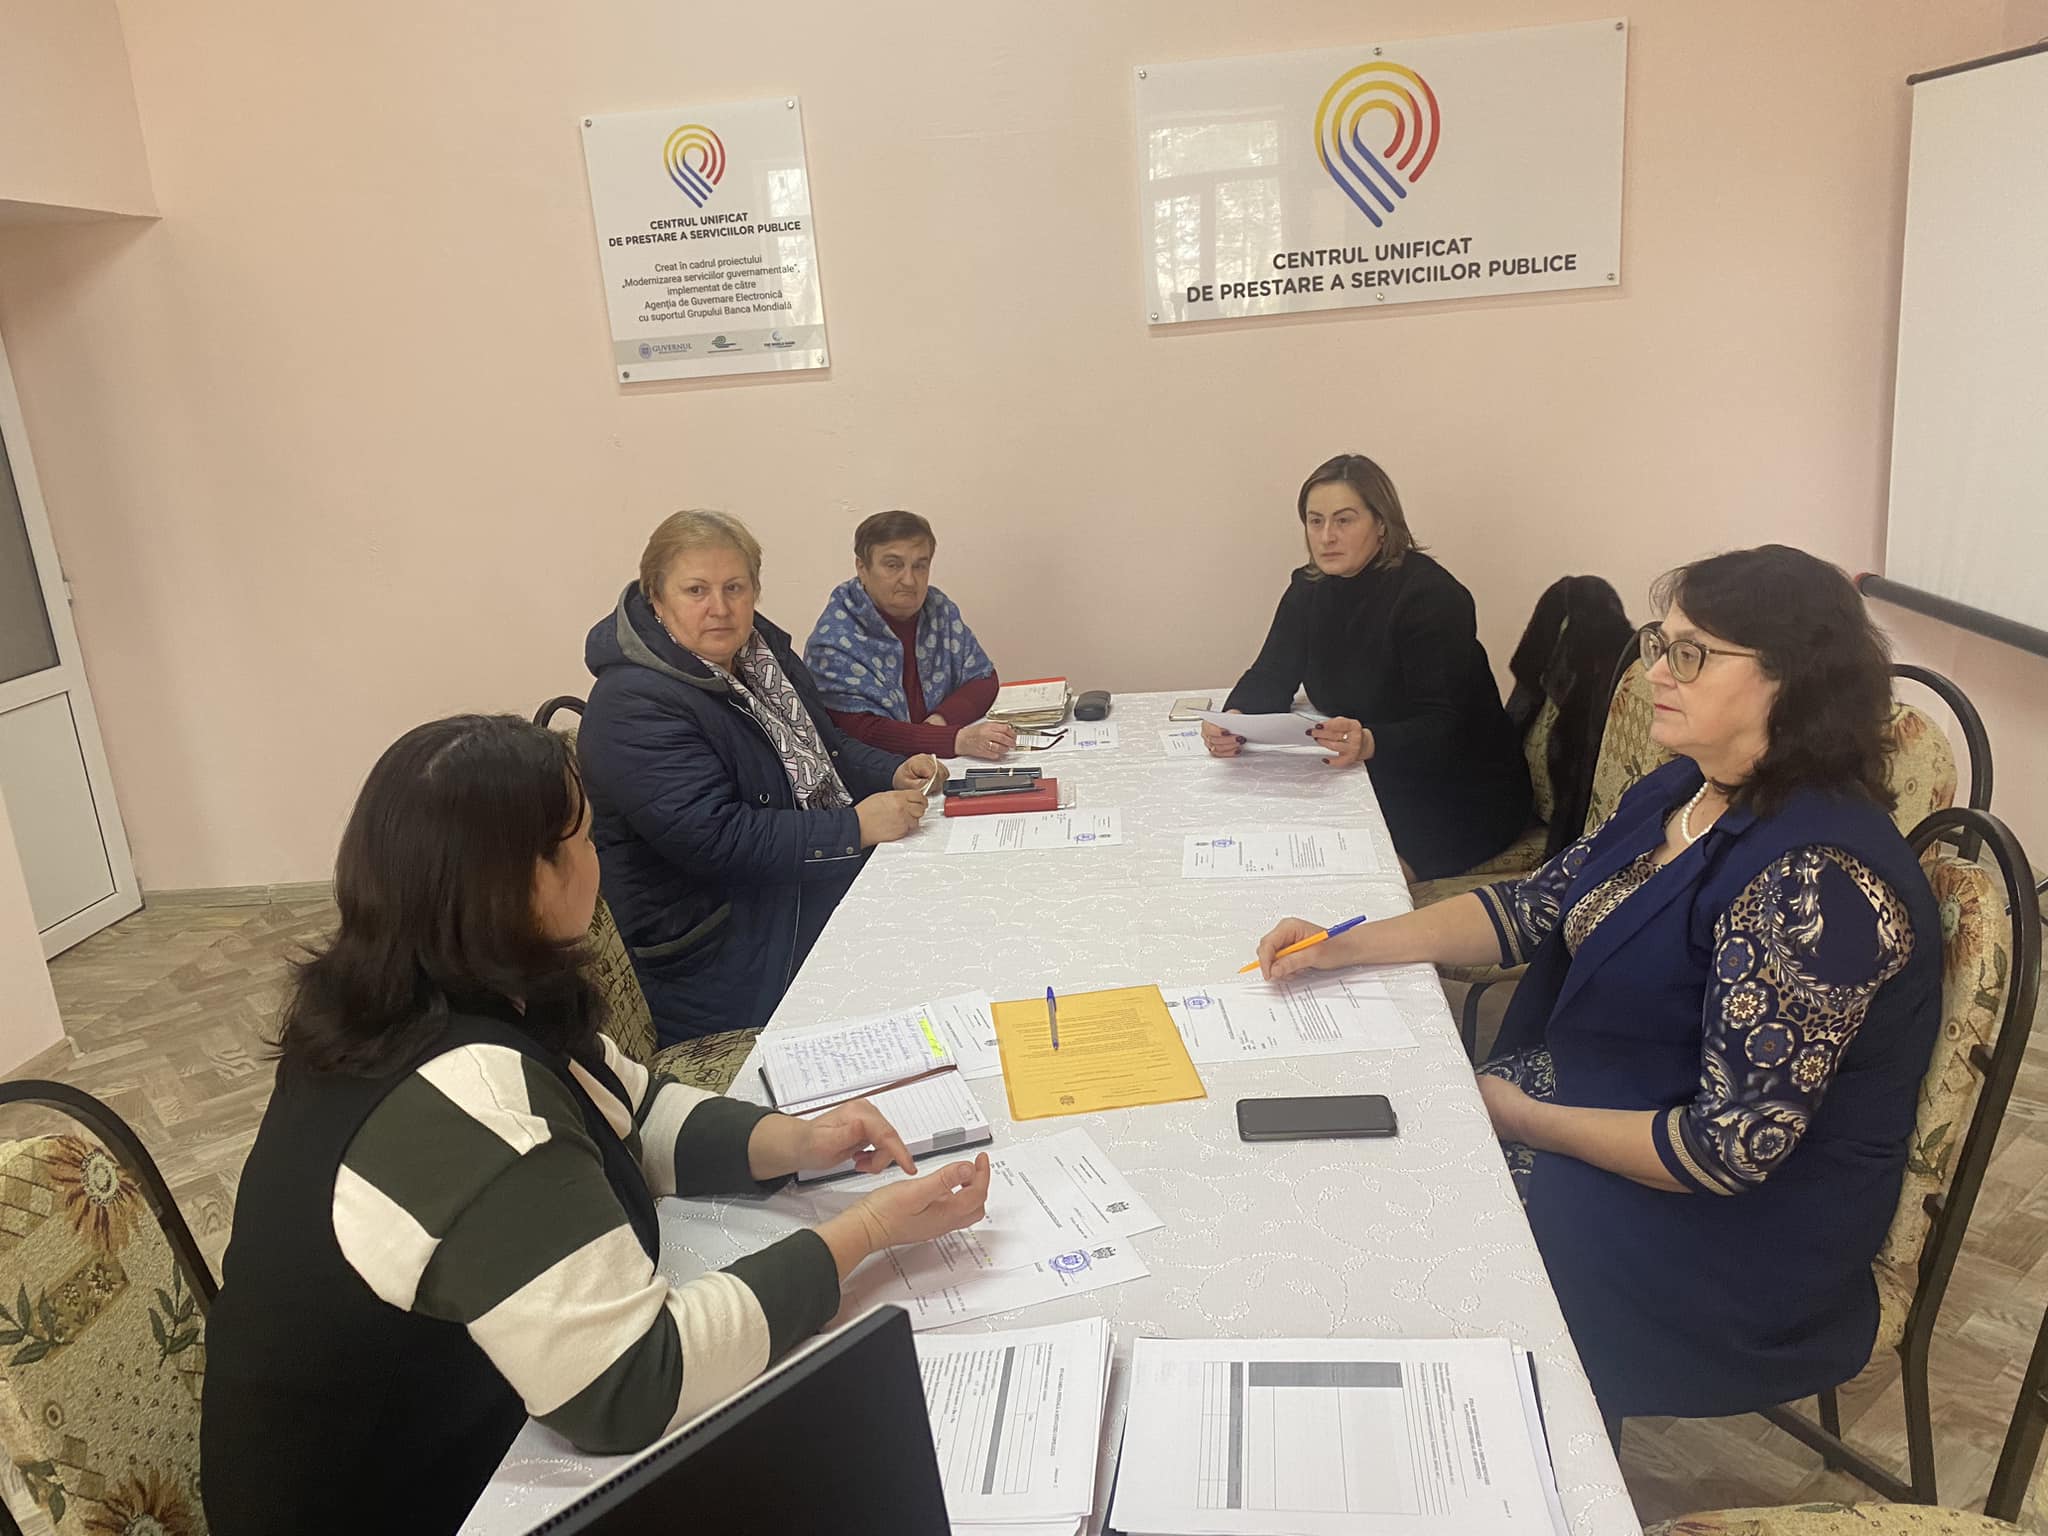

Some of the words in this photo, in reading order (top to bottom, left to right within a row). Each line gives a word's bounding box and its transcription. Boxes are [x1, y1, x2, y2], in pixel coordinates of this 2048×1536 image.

[650, 217, 698, 230] CENTRUL
[700, 212, 748, 225] UNIFICAT
[609, 237, 623, 247] DE
[626, 232, 677, 246] PRESTARE
[680, 231, 688, 240] A
[690, 225, 755, 240] SERVICIILOR
[757, 221, 801, 233] PUBLICE
[1273, 246, 1368, 270] CENTRUL
[1375, 237, 1472, 261] UNIFICAT
[655, 263, 678, 272] Creat
[679, 261, 688, 270] în
[689, 260, 716, 269] cadrul
[717, 255, 762, 268] proiectului
[684, 271, 724, 282] serviciilor
[1187, 285, 1214, 303] DE
[1220, 276, 1324, 300] PRESTARE
[1331, 274, 1344, 291] A
[1351, 262, 1481, 289] SERVICIILOR
[1489, 254, 1577, 277] PUBLICE
[667, 283, 720, 297] implementat
[722, 282, 733, 290] de
[734, 280, 756, 289] către
[678, 298, 689, 307] de
[691, 296, 734, 306] Guvernare
[735, 290, 783, 302] Electronică
[650, 311, 686, 323] suportul
[687, 307, 722, 319] Grupului
[724, 305, 751, 315] Banca
[752, 302, 792, 313] Mondială
